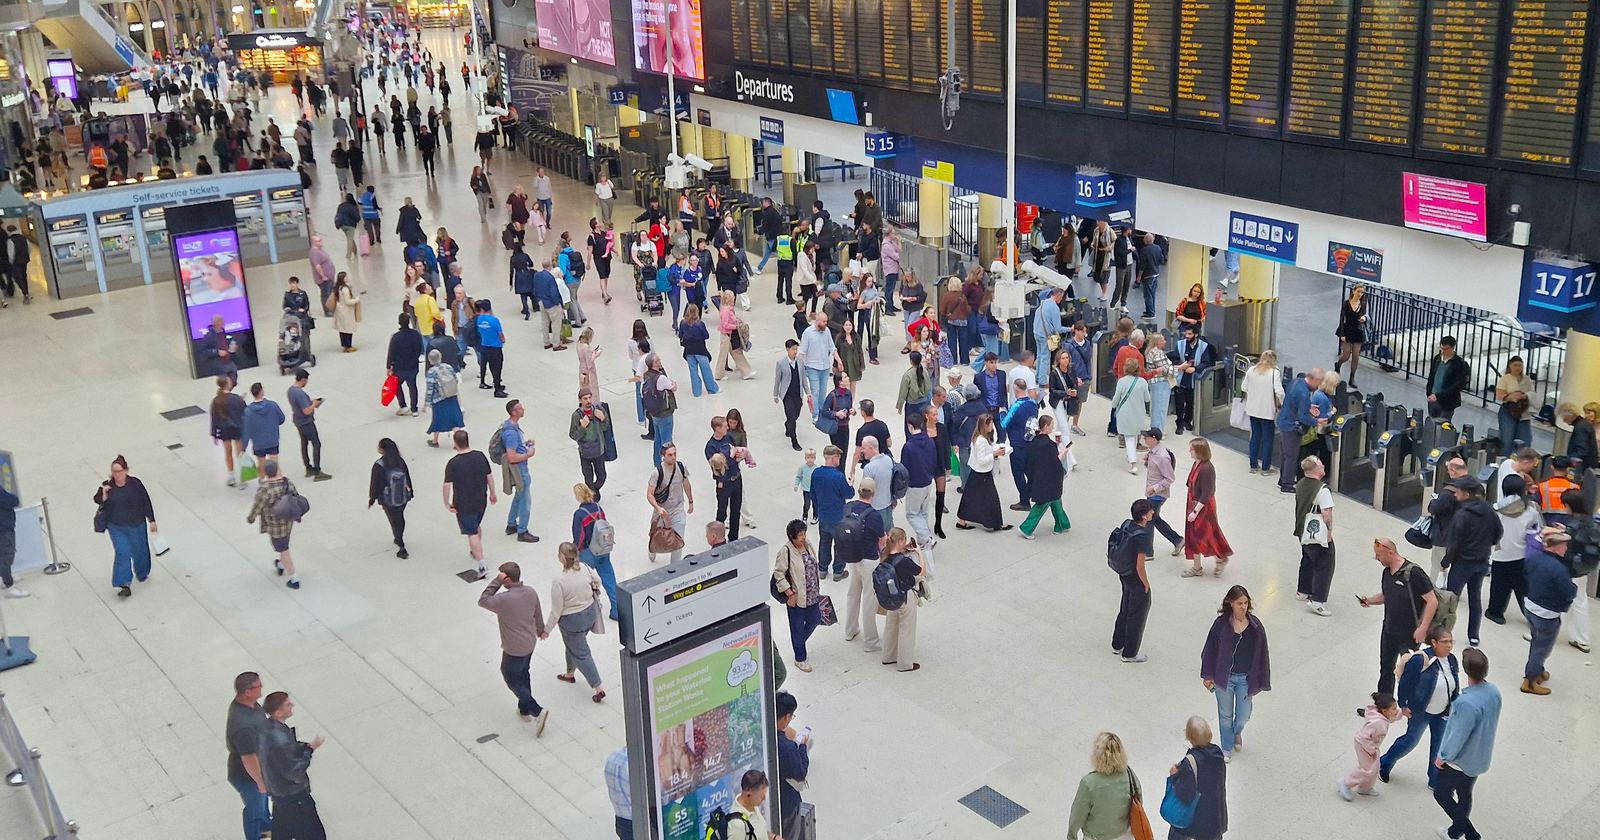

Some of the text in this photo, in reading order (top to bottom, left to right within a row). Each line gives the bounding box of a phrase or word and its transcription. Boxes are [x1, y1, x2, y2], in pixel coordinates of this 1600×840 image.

[735, 70, 794, 103] Departures
[612, 92, 625, 101] 13
[866, 137, 876, 151] 15
[879, 137, 894, 151] 15
[132, 185, 220, 202] Self-service tickets
[1078, 180, 1092, 198] 16
[1098, 180, 1115, 198] 16
[1232, 236, 1278, 253] Wide Platform Gate
[1363, 253, 1382, 266] WiFi
[1535, 272, 1566, 298] 17
[1572, 272, 1596, 298] 17
[672, 578, 698, 590] Platforms
[672, 587, 695, 600] Way out
[675, 610, 694, 622] Tickets
[732, 662, 753, 674] 93.2%
[656, 682, 675, 693] What
[740, 738, 754, 753] 1.9
[703, 752, 722, 770] 14.7
[669, 770, 689, 786] 18.4
[674, 808, 688, 823] 55
